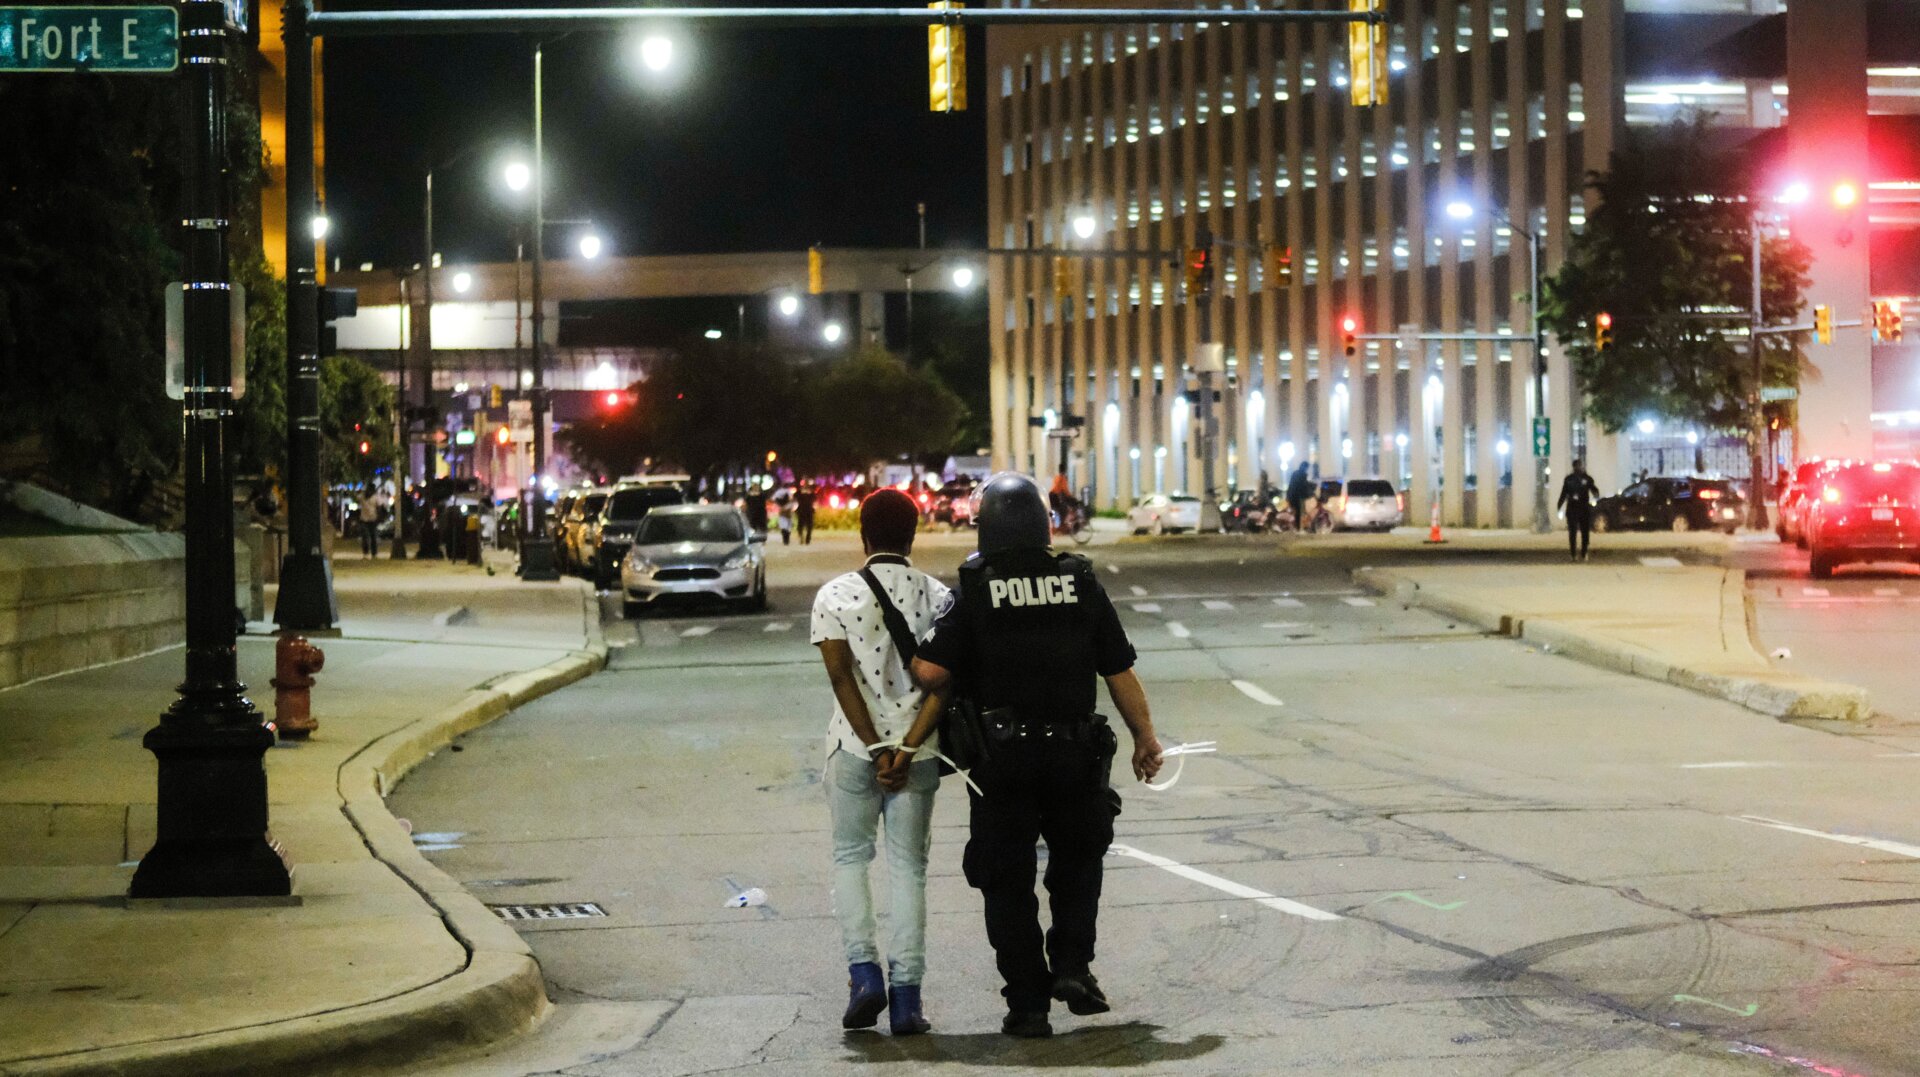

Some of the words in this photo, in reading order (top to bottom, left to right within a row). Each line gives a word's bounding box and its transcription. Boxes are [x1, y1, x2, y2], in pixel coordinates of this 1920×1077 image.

[21, 17, 102, 59] Fort
[122, 18, 139, 59] E
[989, 575, 1078, 608] POLICE
